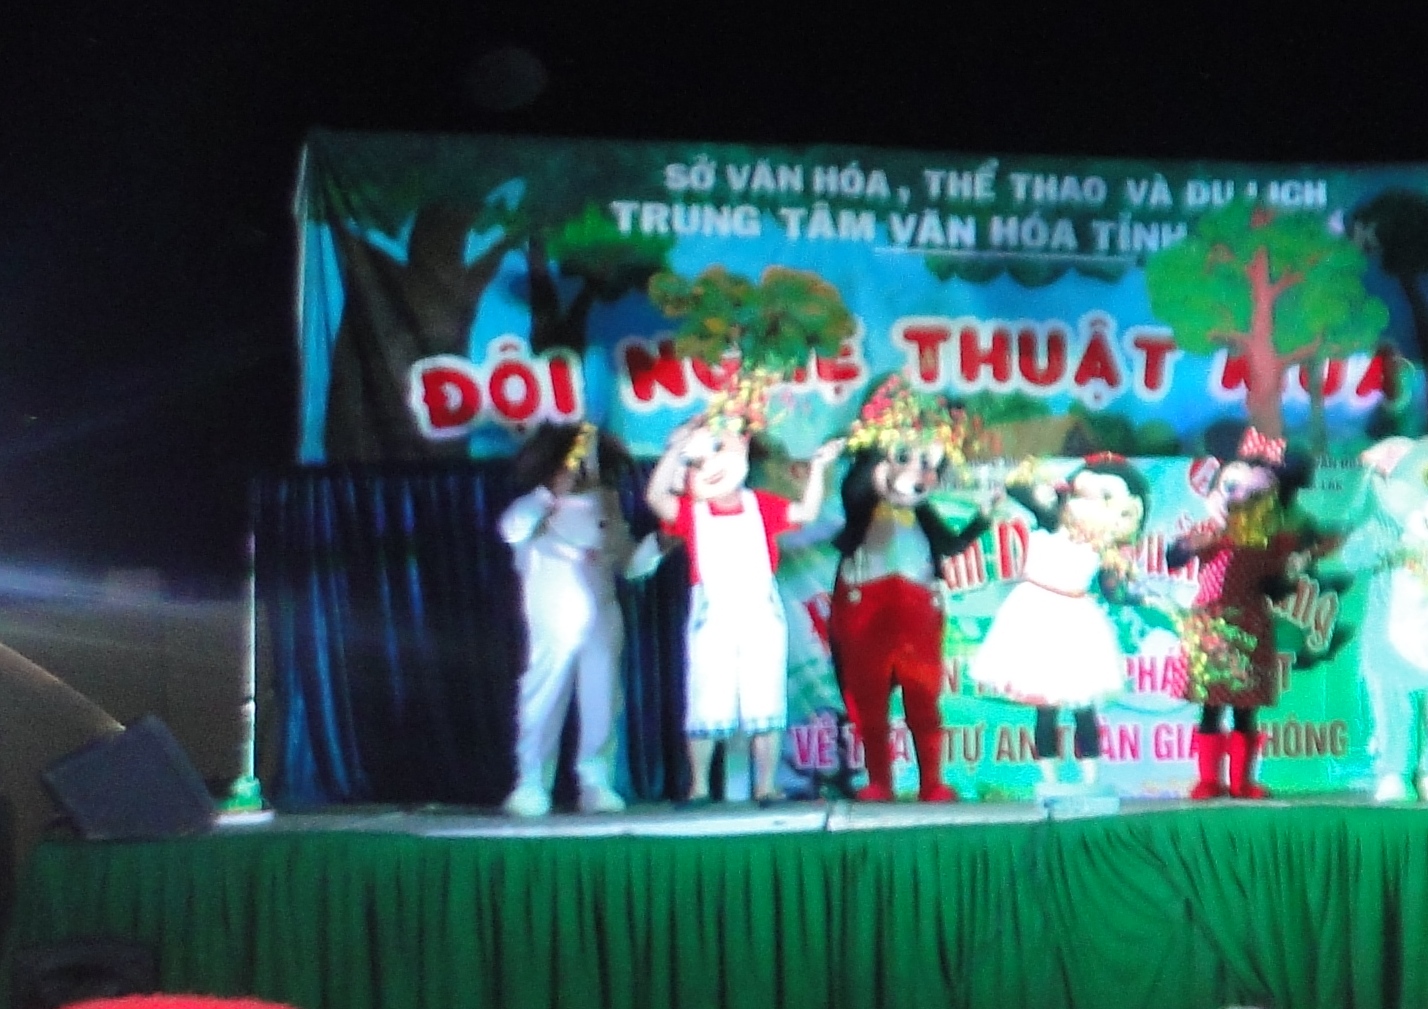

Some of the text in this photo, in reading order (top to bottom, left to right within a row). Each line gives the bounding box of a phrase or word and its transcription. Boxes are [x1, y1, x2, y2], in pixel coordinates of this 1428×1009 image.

[664, 153, 716, 192] SỞ
[924, 158, 998, 201] THỂ
[1009, 172, 1108, 205] THAO
[1126, 173, 1173, 207] VÀ
[611, 200, 761, 237] TRUNG
[779, 200, 876, 242] TÂM
[888, 208, 976, 247] VĂN
[989, 209, 1078, 249] HÓA
[413, 338, 582, 436] ĐỘI
[897, 314, 1180, 404] THUẬT
